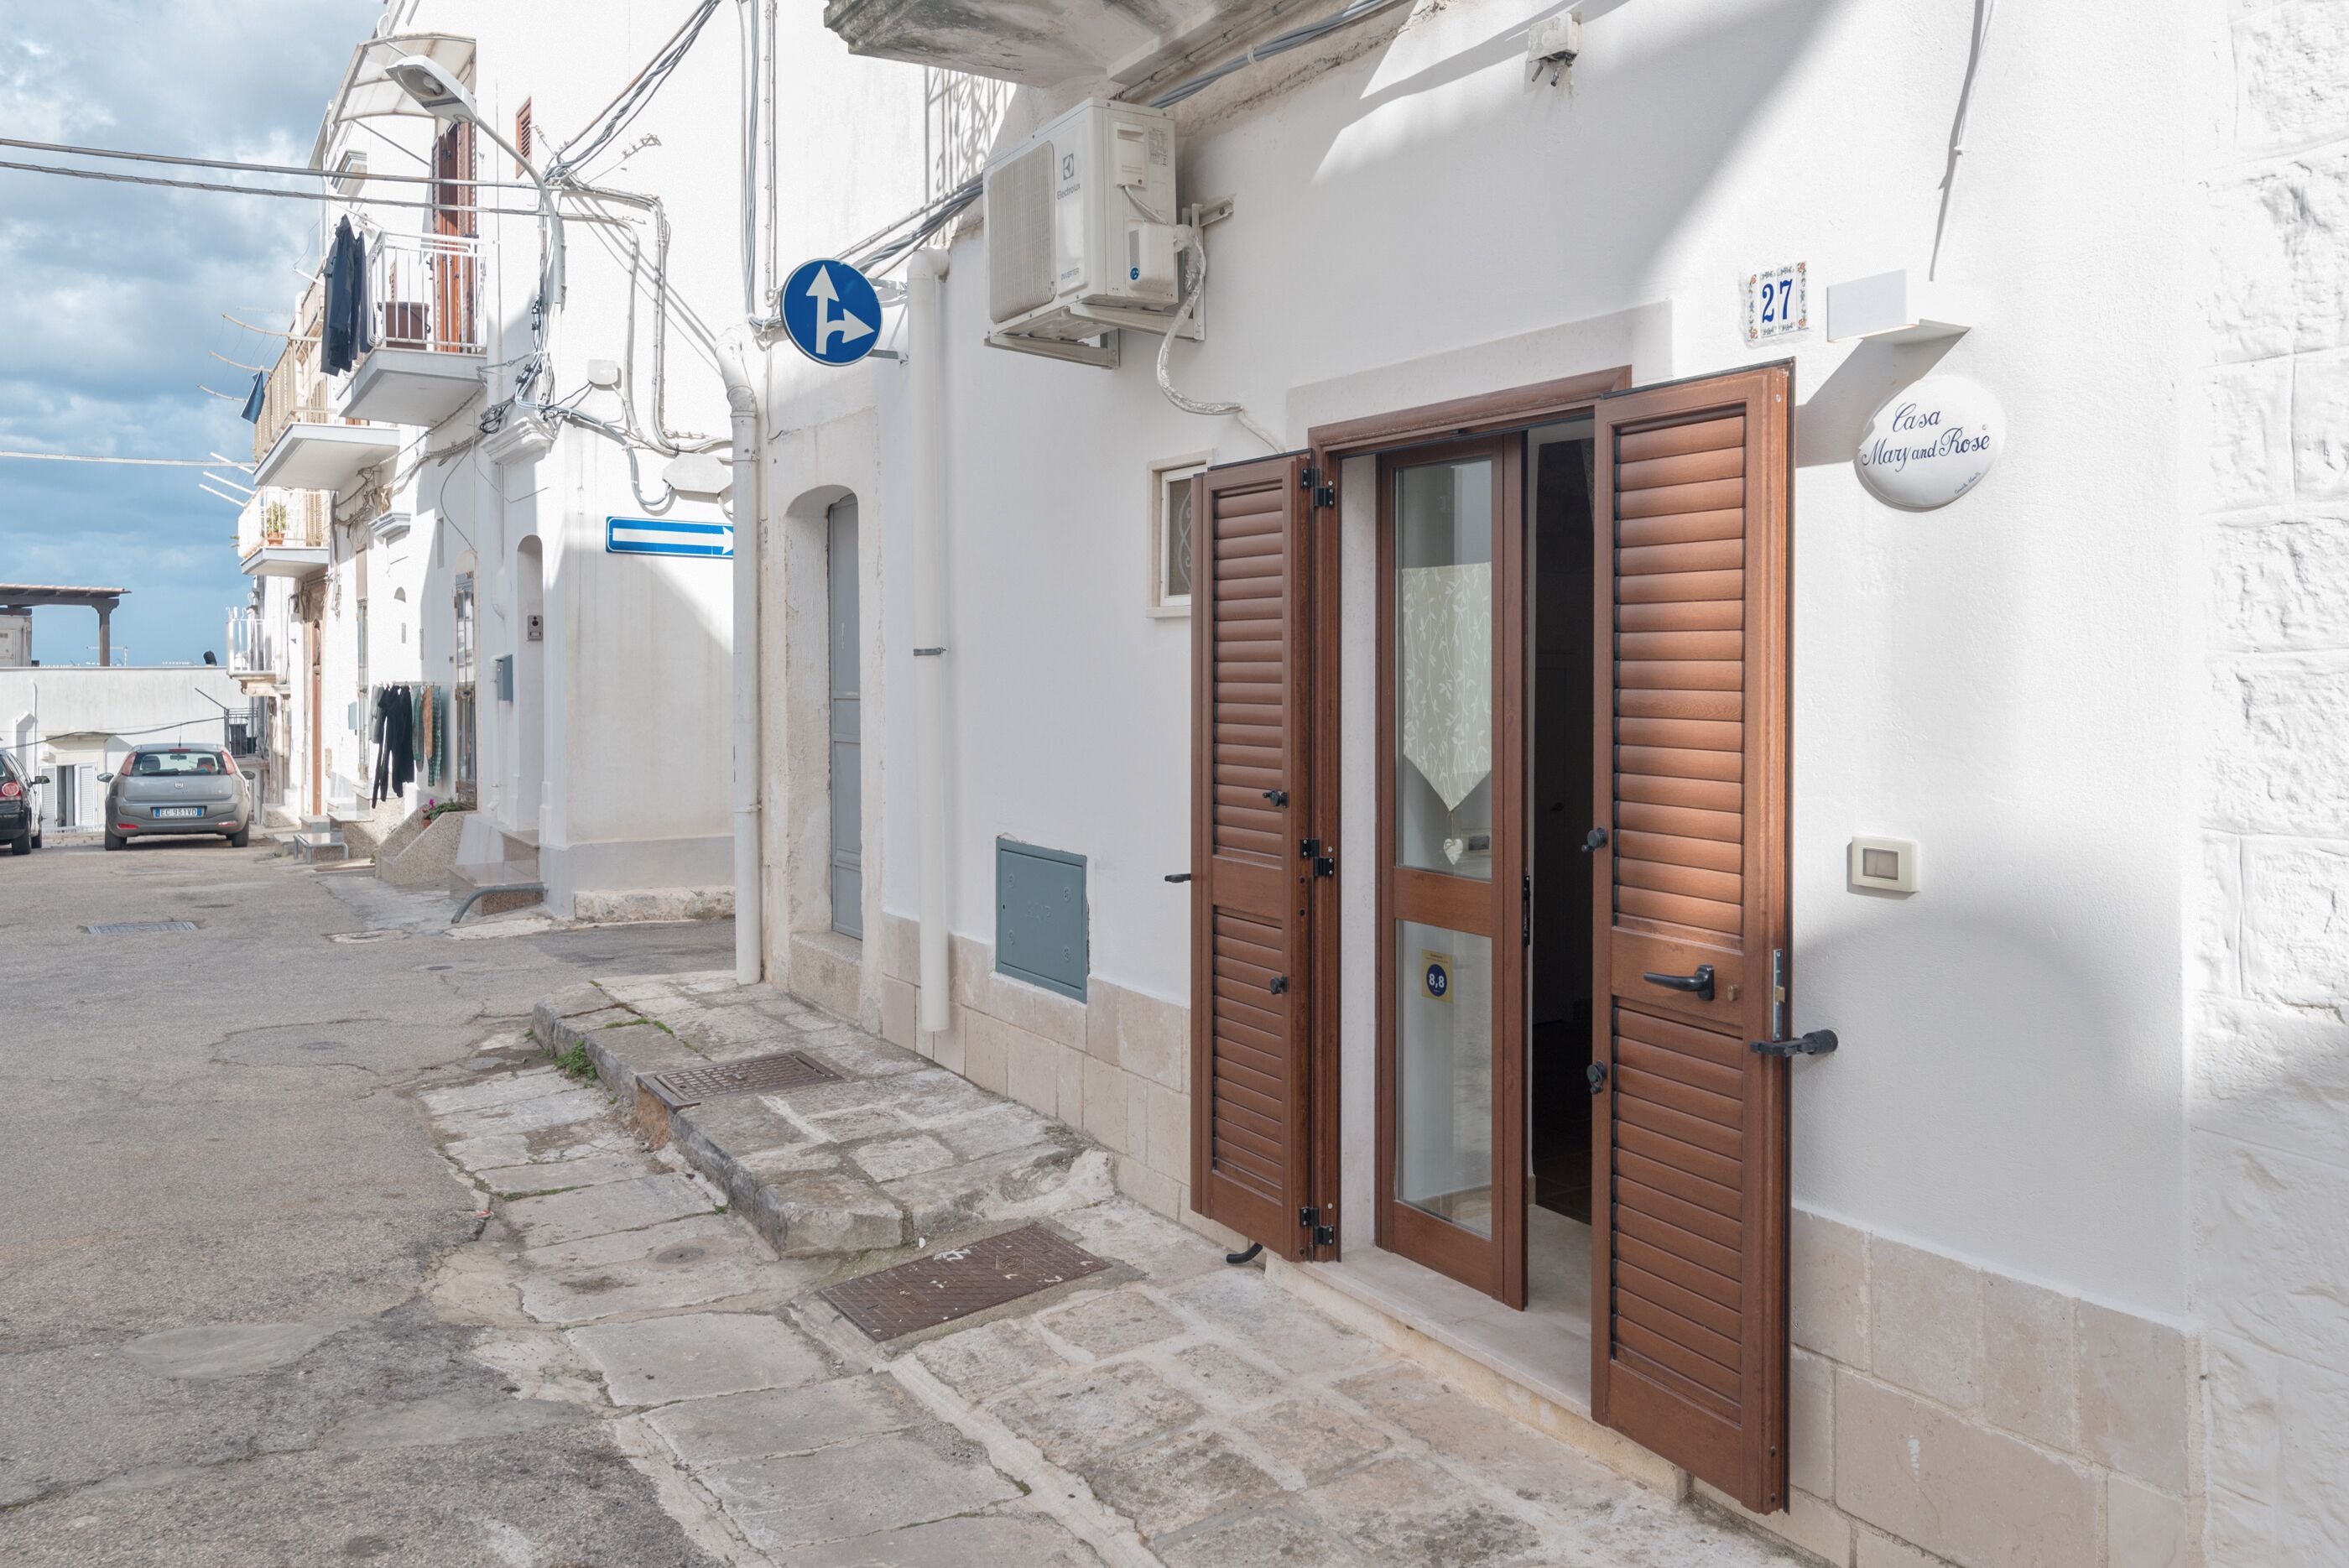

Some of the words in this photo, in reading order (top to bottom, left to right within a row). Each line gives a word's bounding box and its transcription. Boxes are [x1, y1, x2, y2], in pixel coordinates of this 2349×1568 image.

[1057, 183, 1081, 201] Electrolux
[1762, 279, 1793, 323] 27
[1893, 402, 1941, 432] Casa
[1861, 437, 1911, 472] Mary
[1911, 440, 1937, 461] and
[1939, 426, 1990, 456] Rose
[1429, 973, 1445, 988] 8,8
